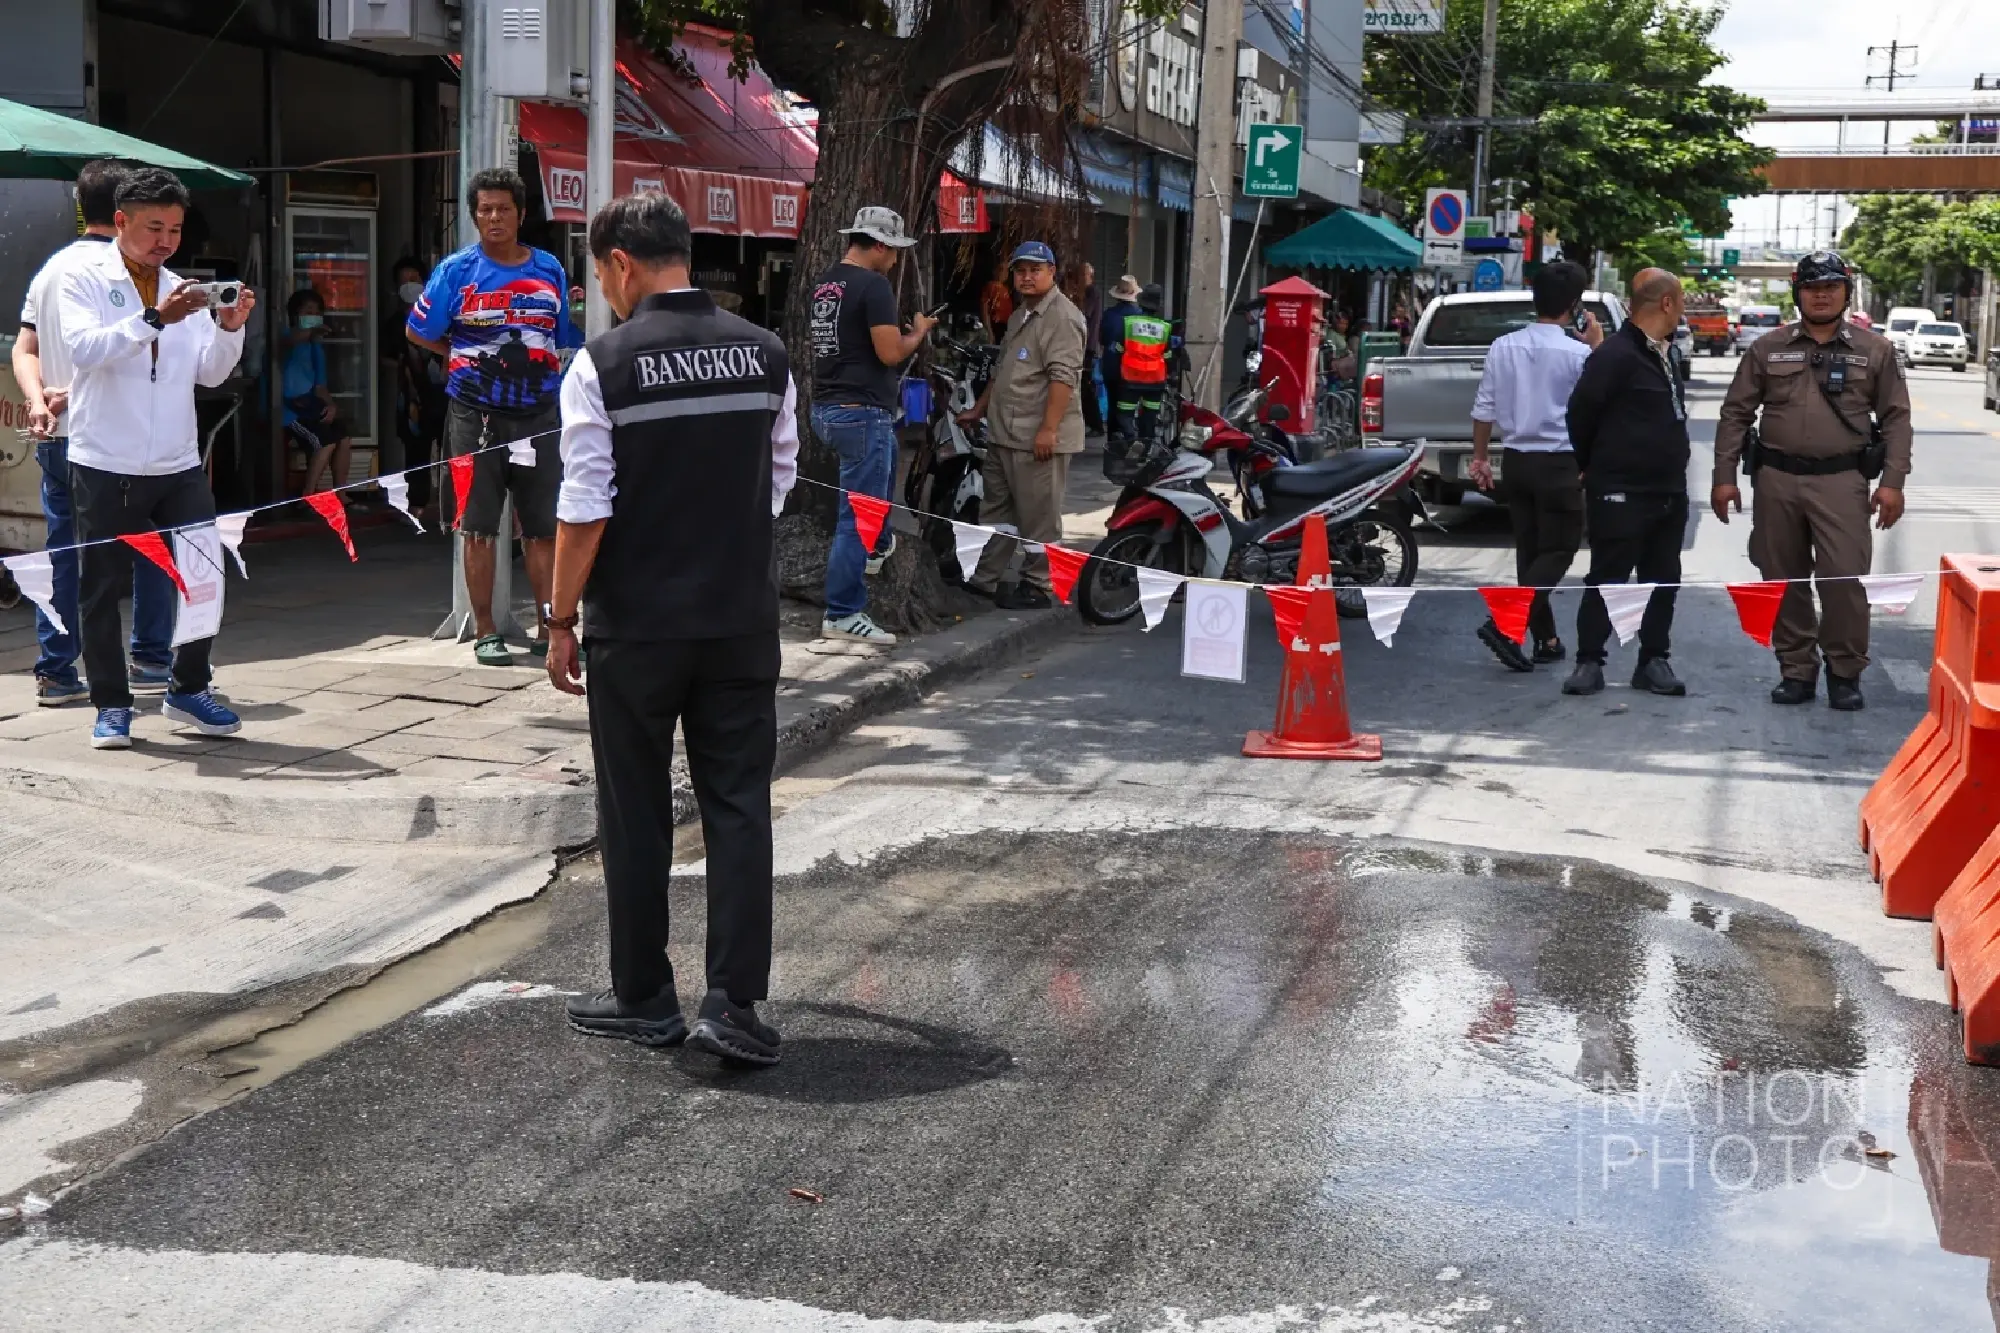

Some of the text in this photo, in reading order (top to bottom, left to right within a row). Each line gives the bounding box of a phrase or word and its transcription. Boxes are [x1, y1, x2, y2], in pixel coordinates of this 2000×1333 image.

[552, 172, 583, 203] LEO
[710, 192, 732, 217] LEO
[775, 198, 795, 222] LEO
[637, 345, 765, 388] BANGKOK
